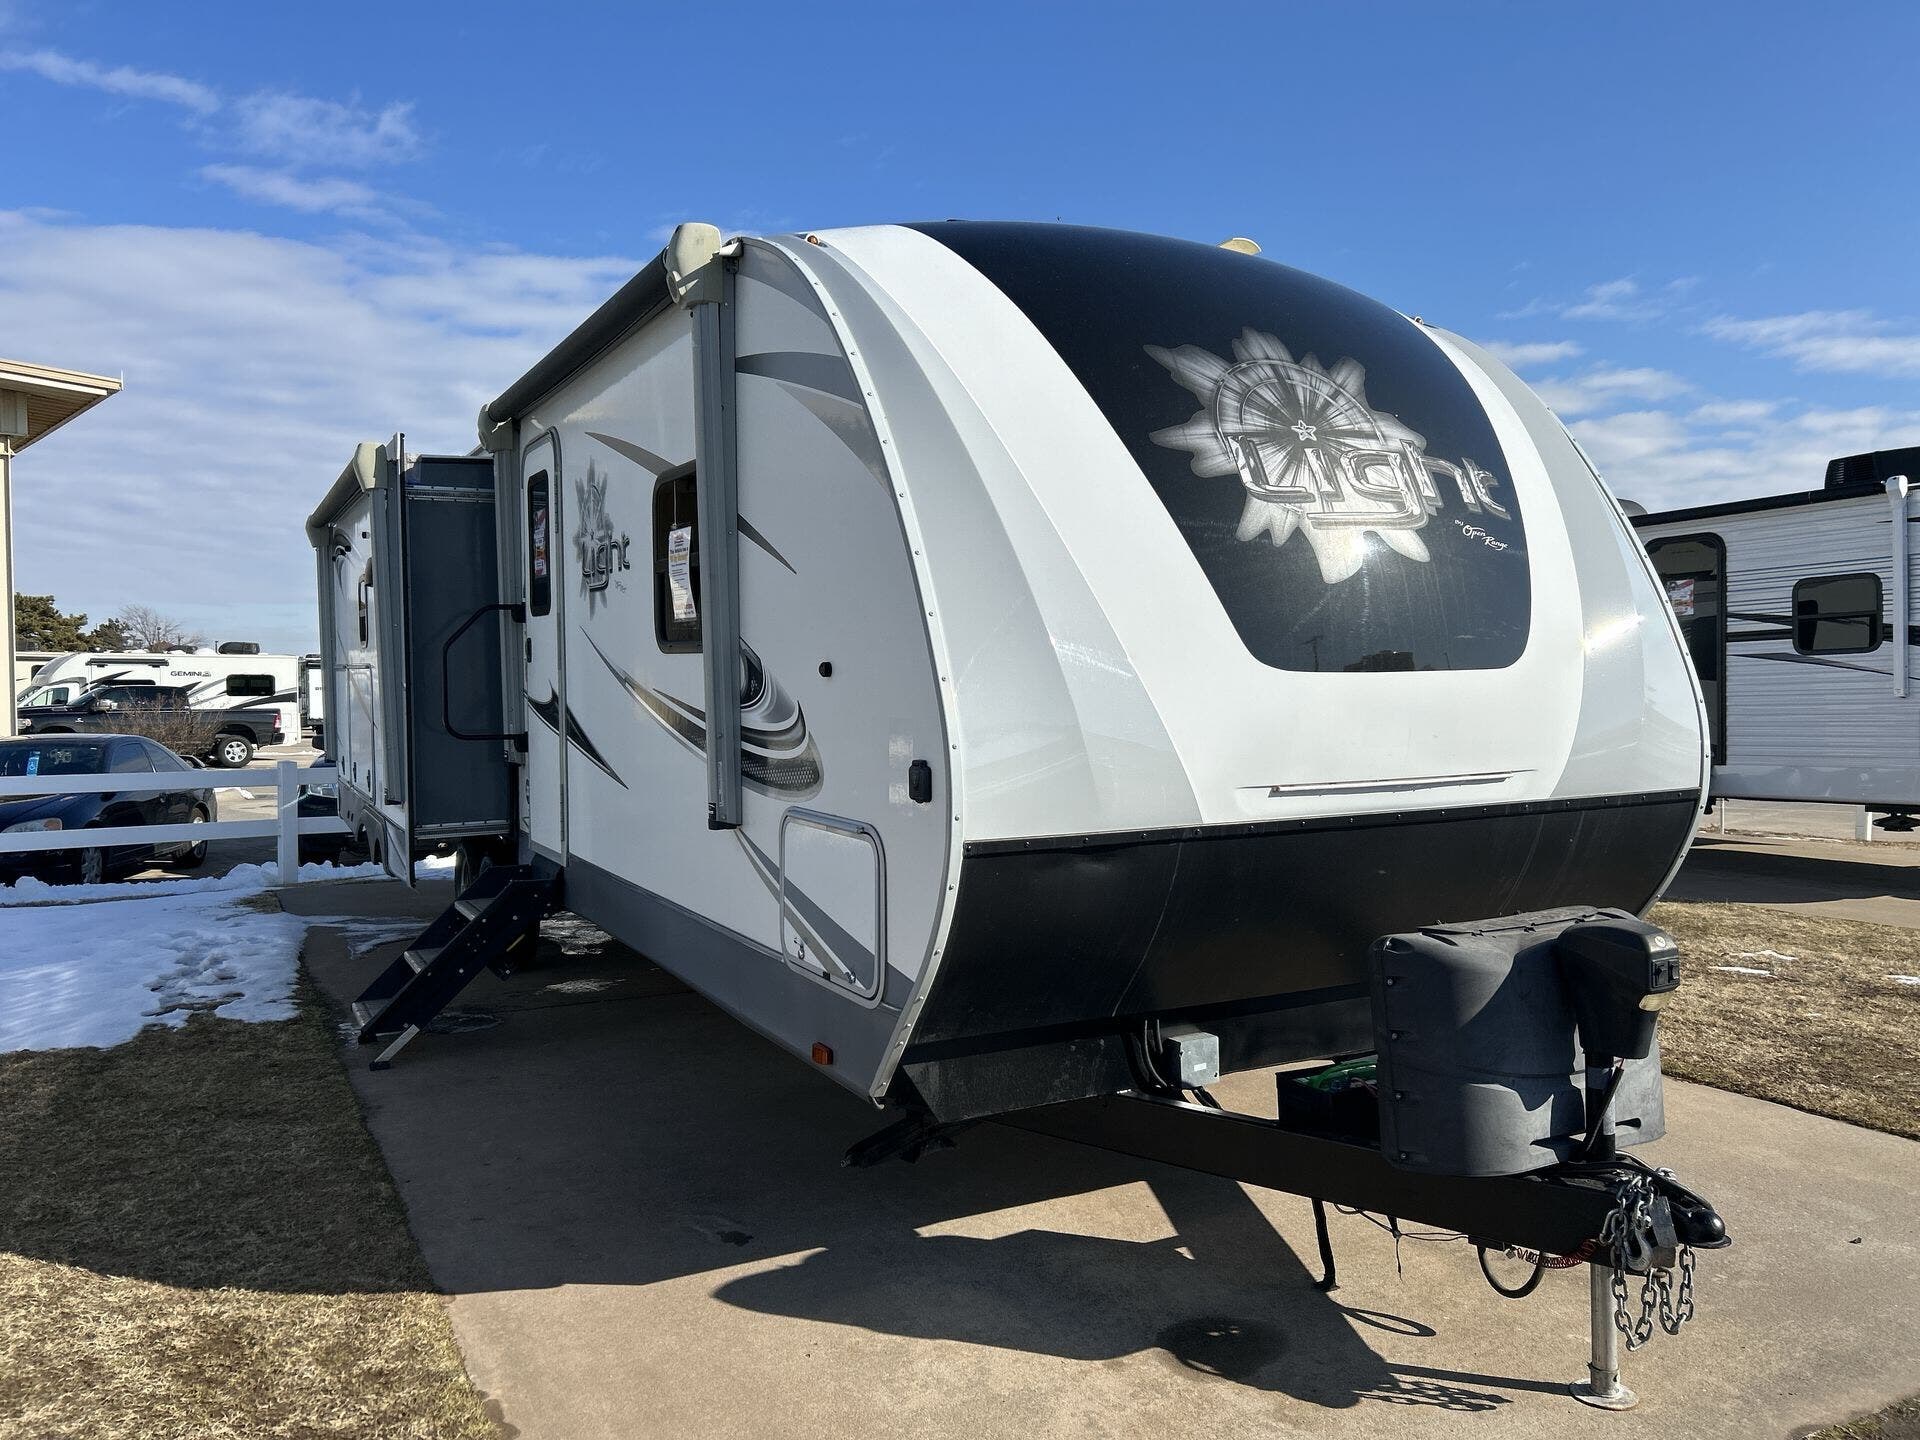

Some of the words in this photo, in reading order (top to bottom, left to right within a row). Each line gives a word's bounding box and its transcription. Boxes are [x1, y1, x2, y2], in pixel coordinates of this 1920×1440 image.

[1227, 436, 1511, 530] Light
[1463, 525, 1486, 539] Open
[1482, 536, 1508, 551] Range
